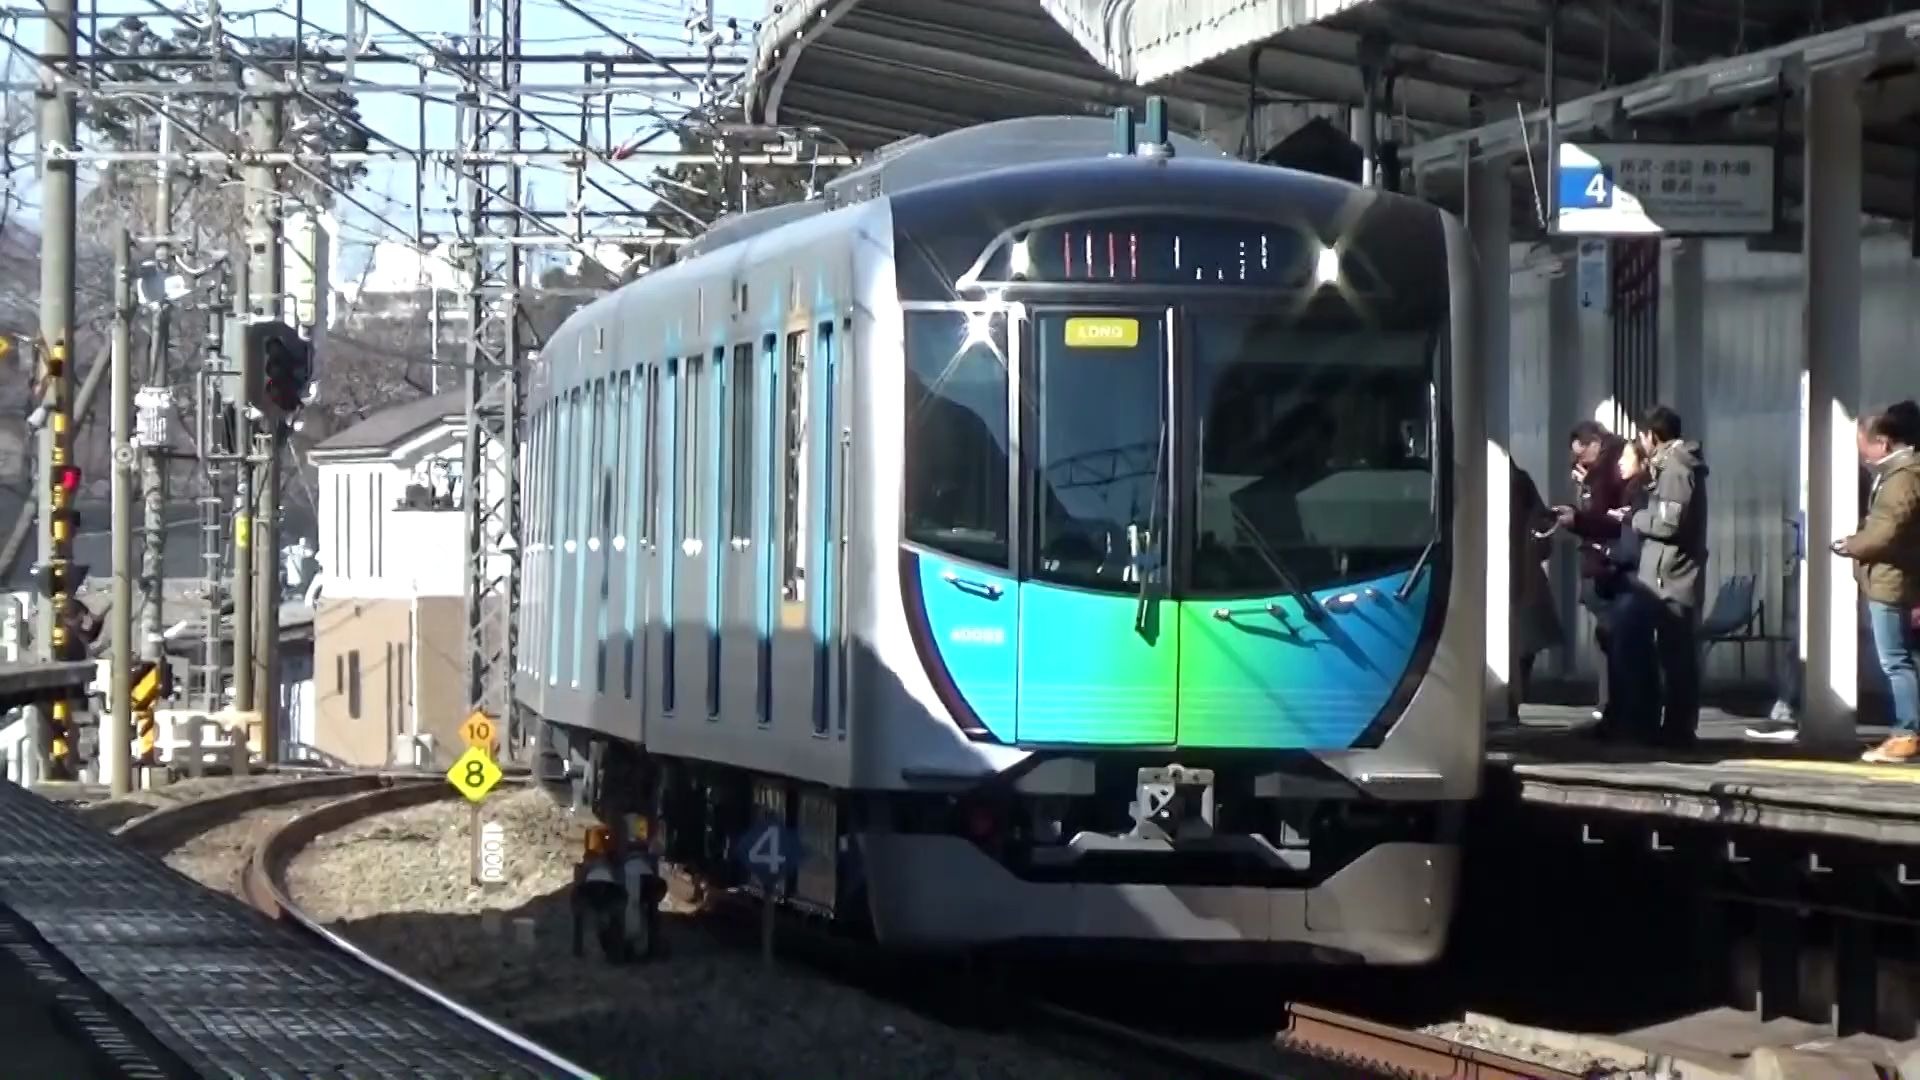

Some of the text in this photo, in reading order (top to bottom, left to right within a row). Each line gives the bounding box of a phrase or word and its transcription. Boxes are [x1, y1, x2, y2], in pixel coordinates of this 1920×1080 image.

[1585, 173, 1607, 203] 4
[469, 722, 490, 740] 10
[465, 760, 485, 788] 8
[749, 826, 786, 874] 4
